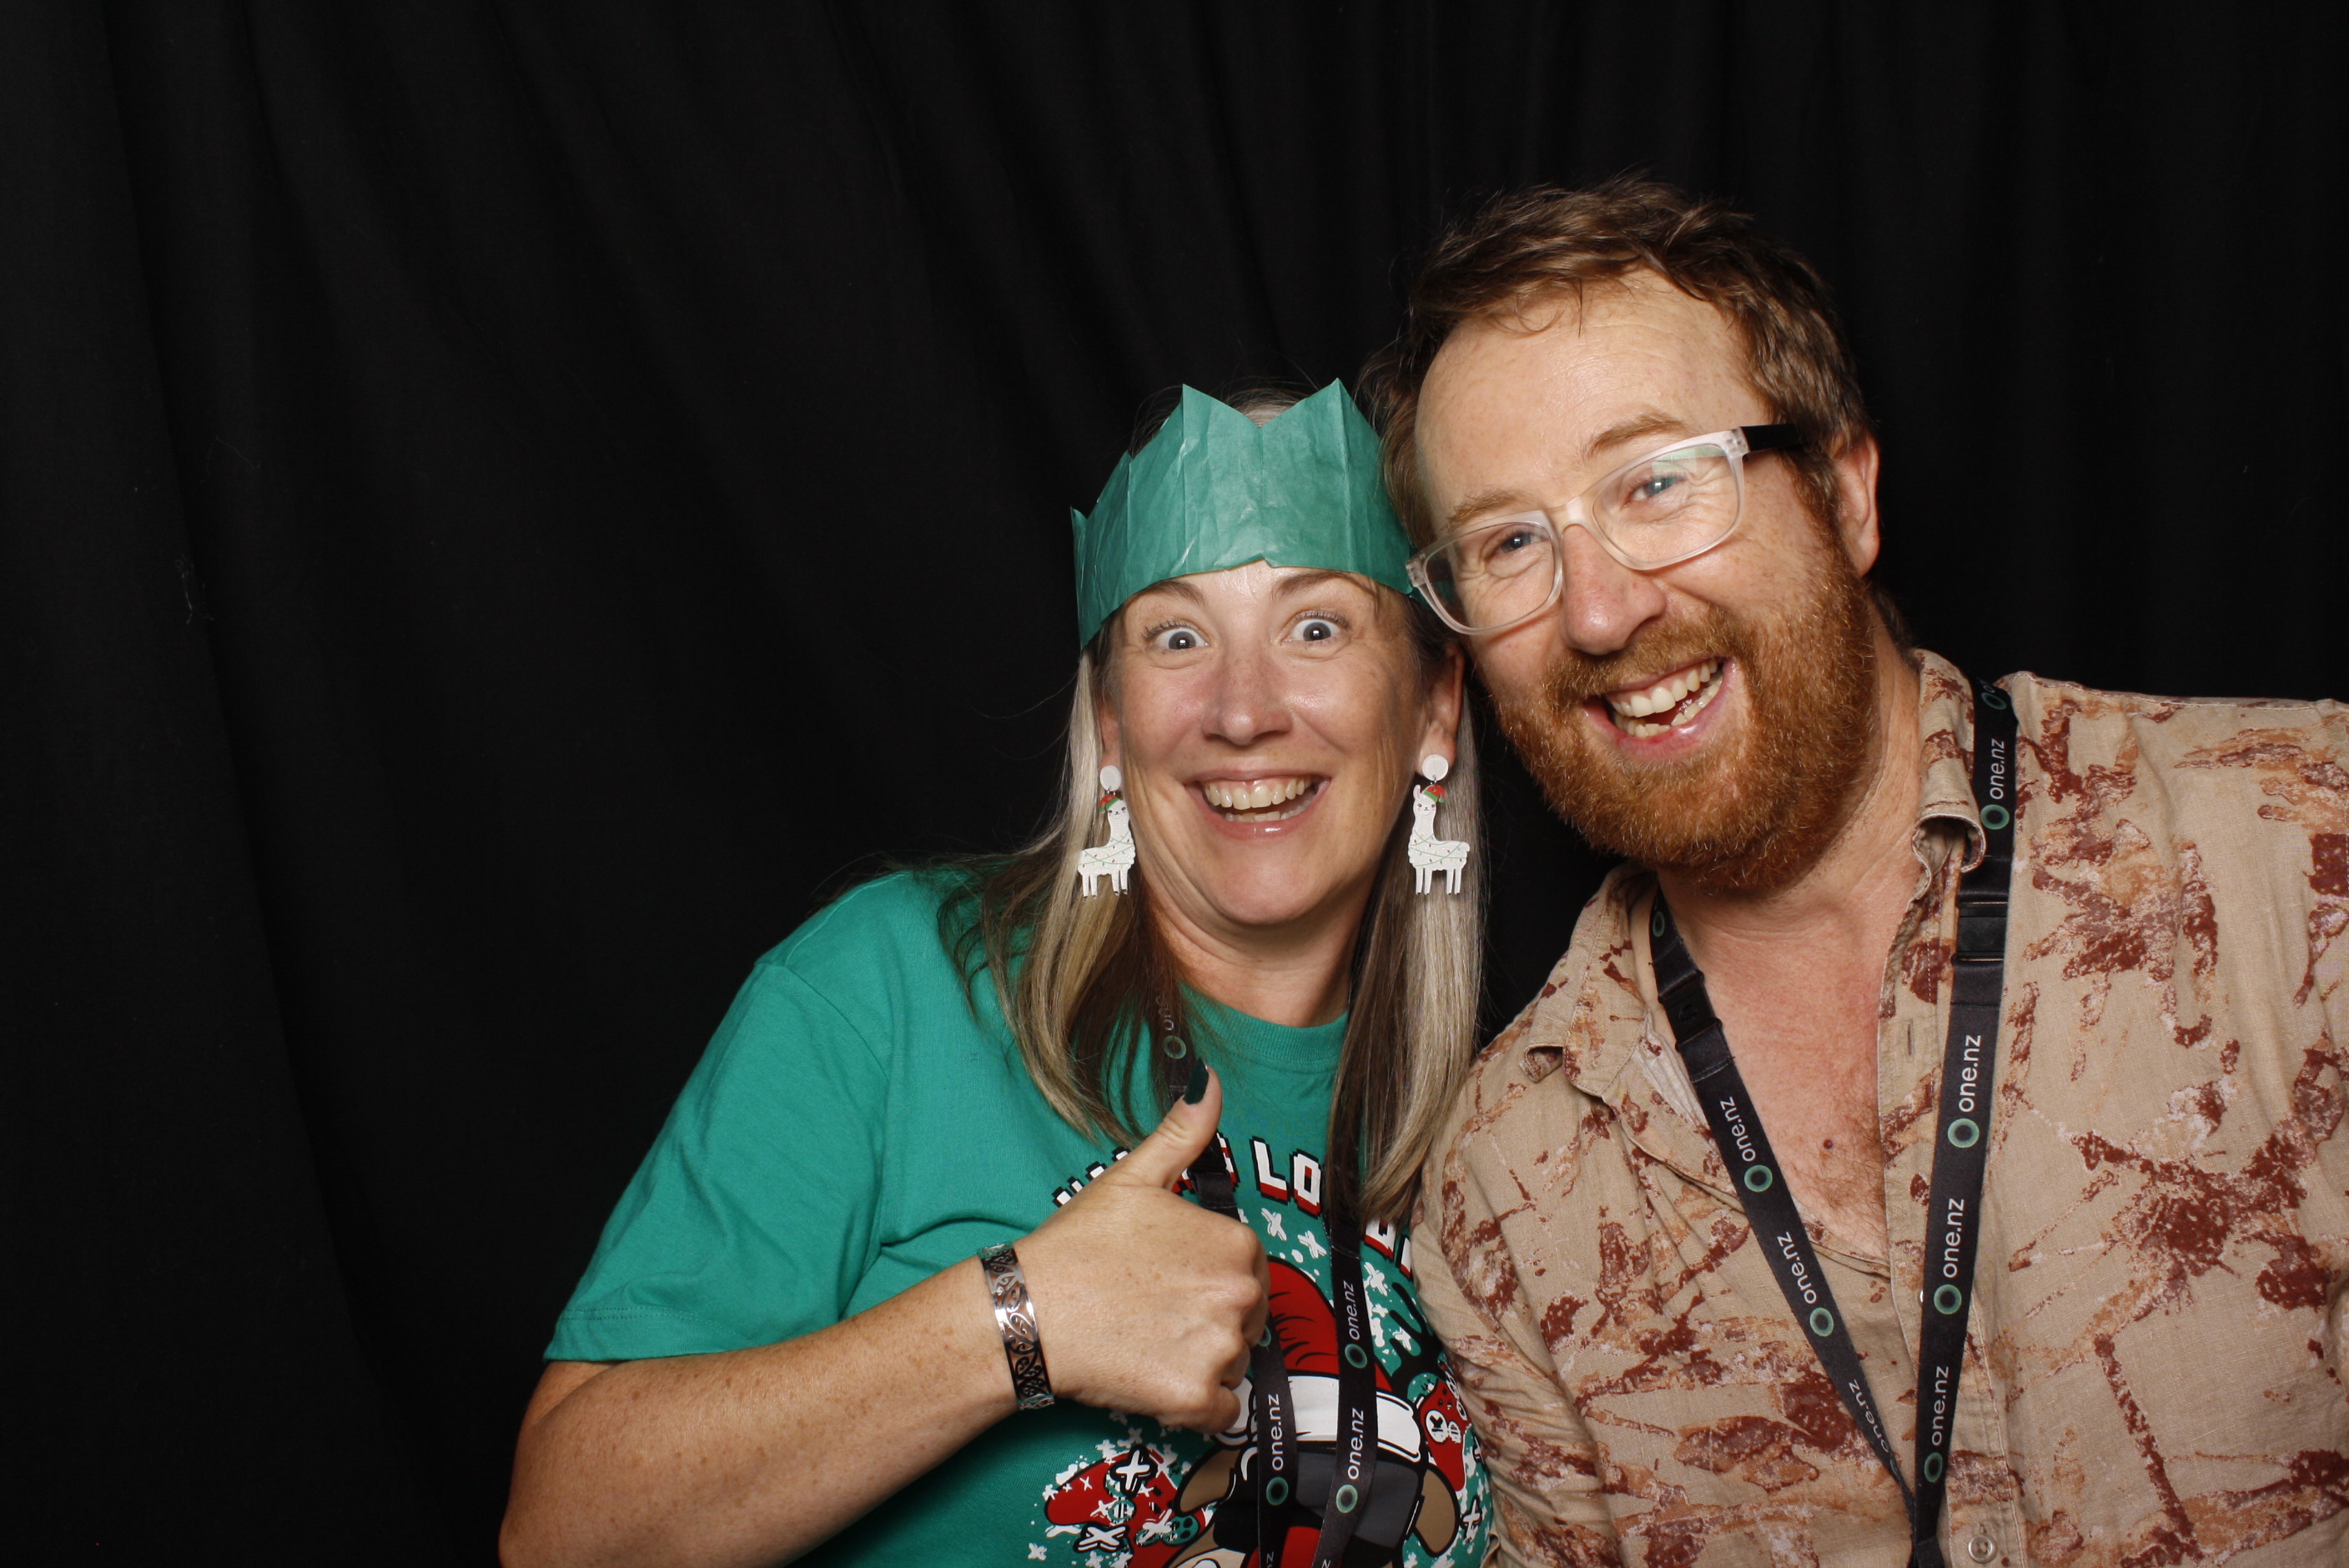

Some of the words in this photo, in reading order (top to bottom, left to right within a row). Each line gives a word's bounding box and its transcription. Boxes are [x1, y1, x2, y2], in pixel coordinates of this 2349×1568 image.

[1989, 738, 2005, 800] one.nz
[1958, 1034, 1981, 1113] one.nz
[1720, 1095, 1757, 1163] one.nz
[1777, 1231, 1818, 1305] one.nz
[1943, 1198, 1964, 1279] one.nz
[1343, 1280, 1361, 1341] one.nz
[1267, 1393, 1284, 1471] one.nz
[1848, 1379, 1890, 1453] one.nz
[1930, 1365, 1949, 1447] one.nz
[1347, 1407, 1364, 1480] one.nz
